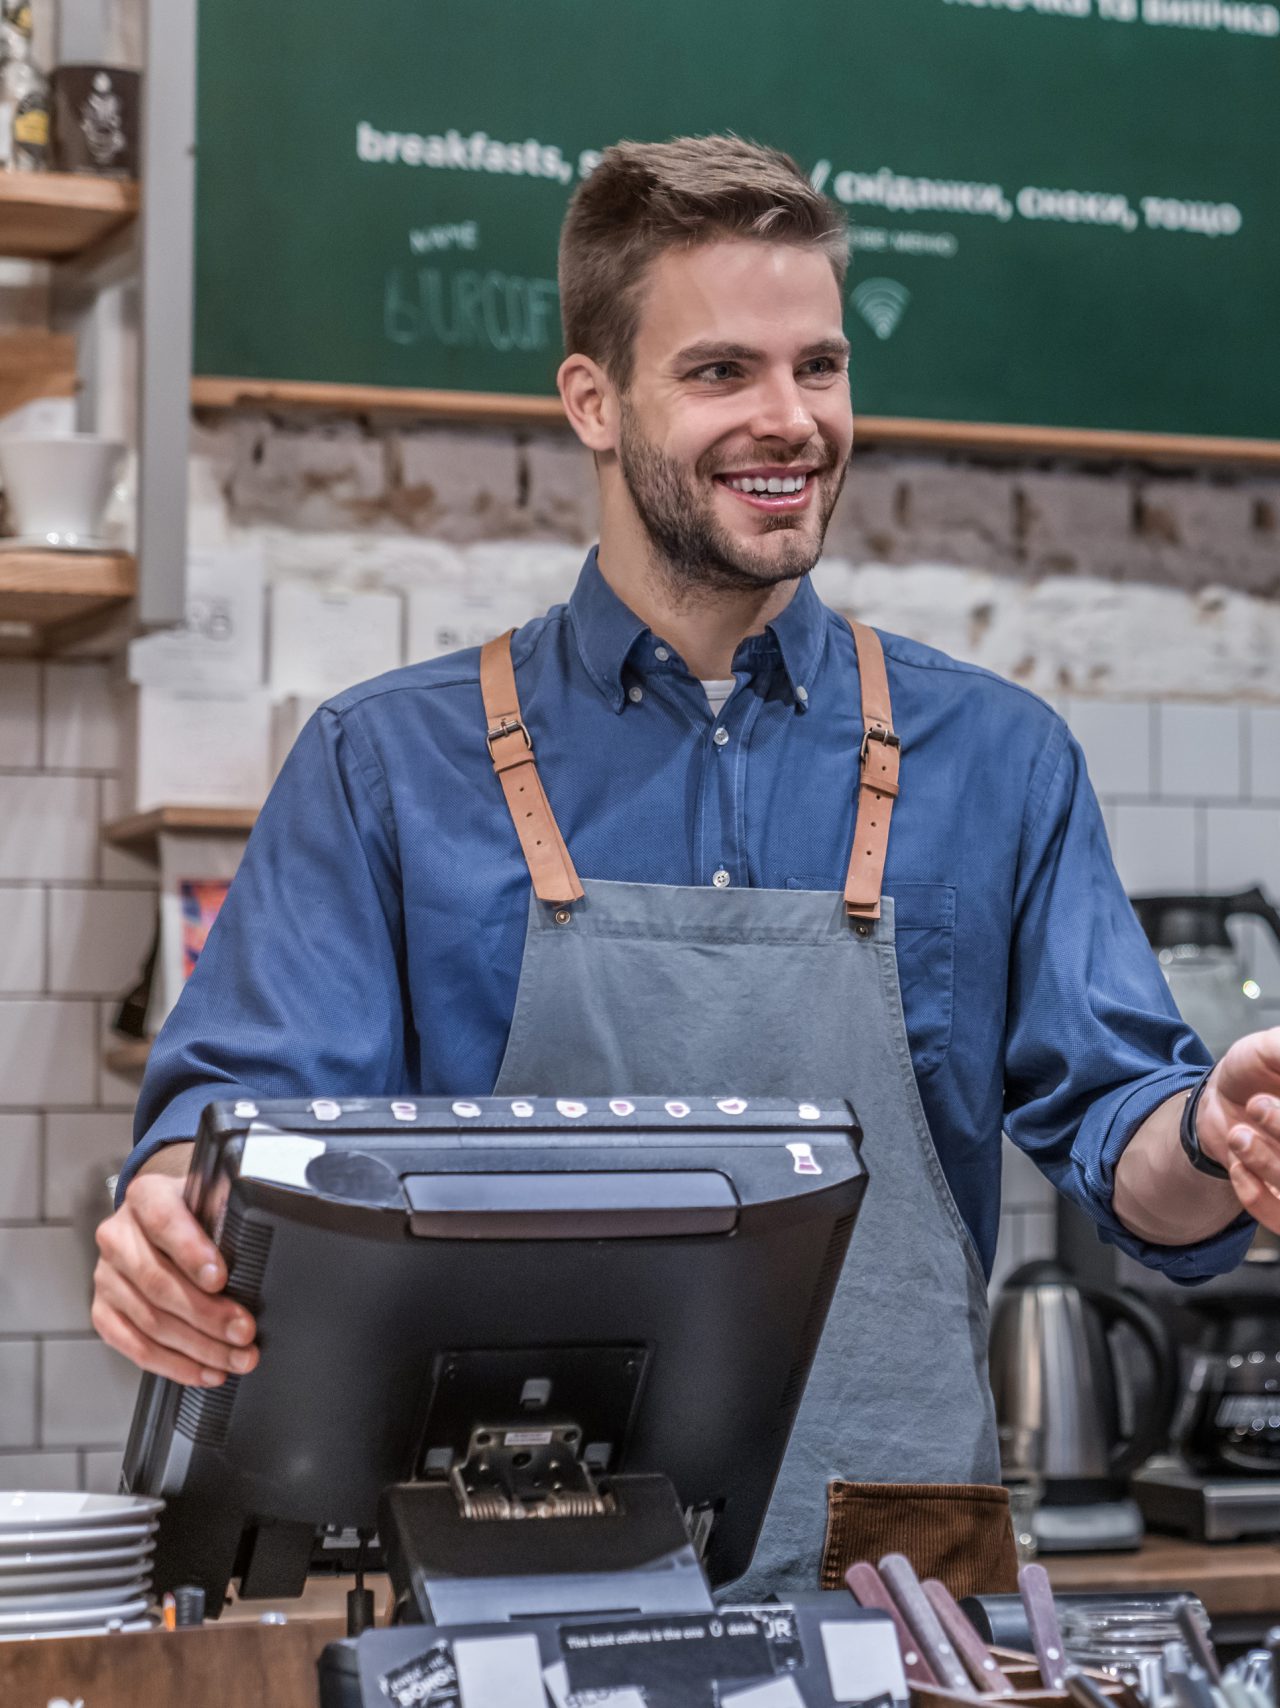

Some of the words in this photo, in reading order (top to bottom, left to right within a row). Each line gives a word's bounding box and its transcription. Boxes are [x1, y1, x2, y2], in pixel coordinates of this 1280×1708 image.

[356, 120, 573, 185] breakfasts,
[1139, 196, 1242, 237] тощо
[589, 1632, 615, 1648] best
[616, 1628, 651, 1645] coffee
